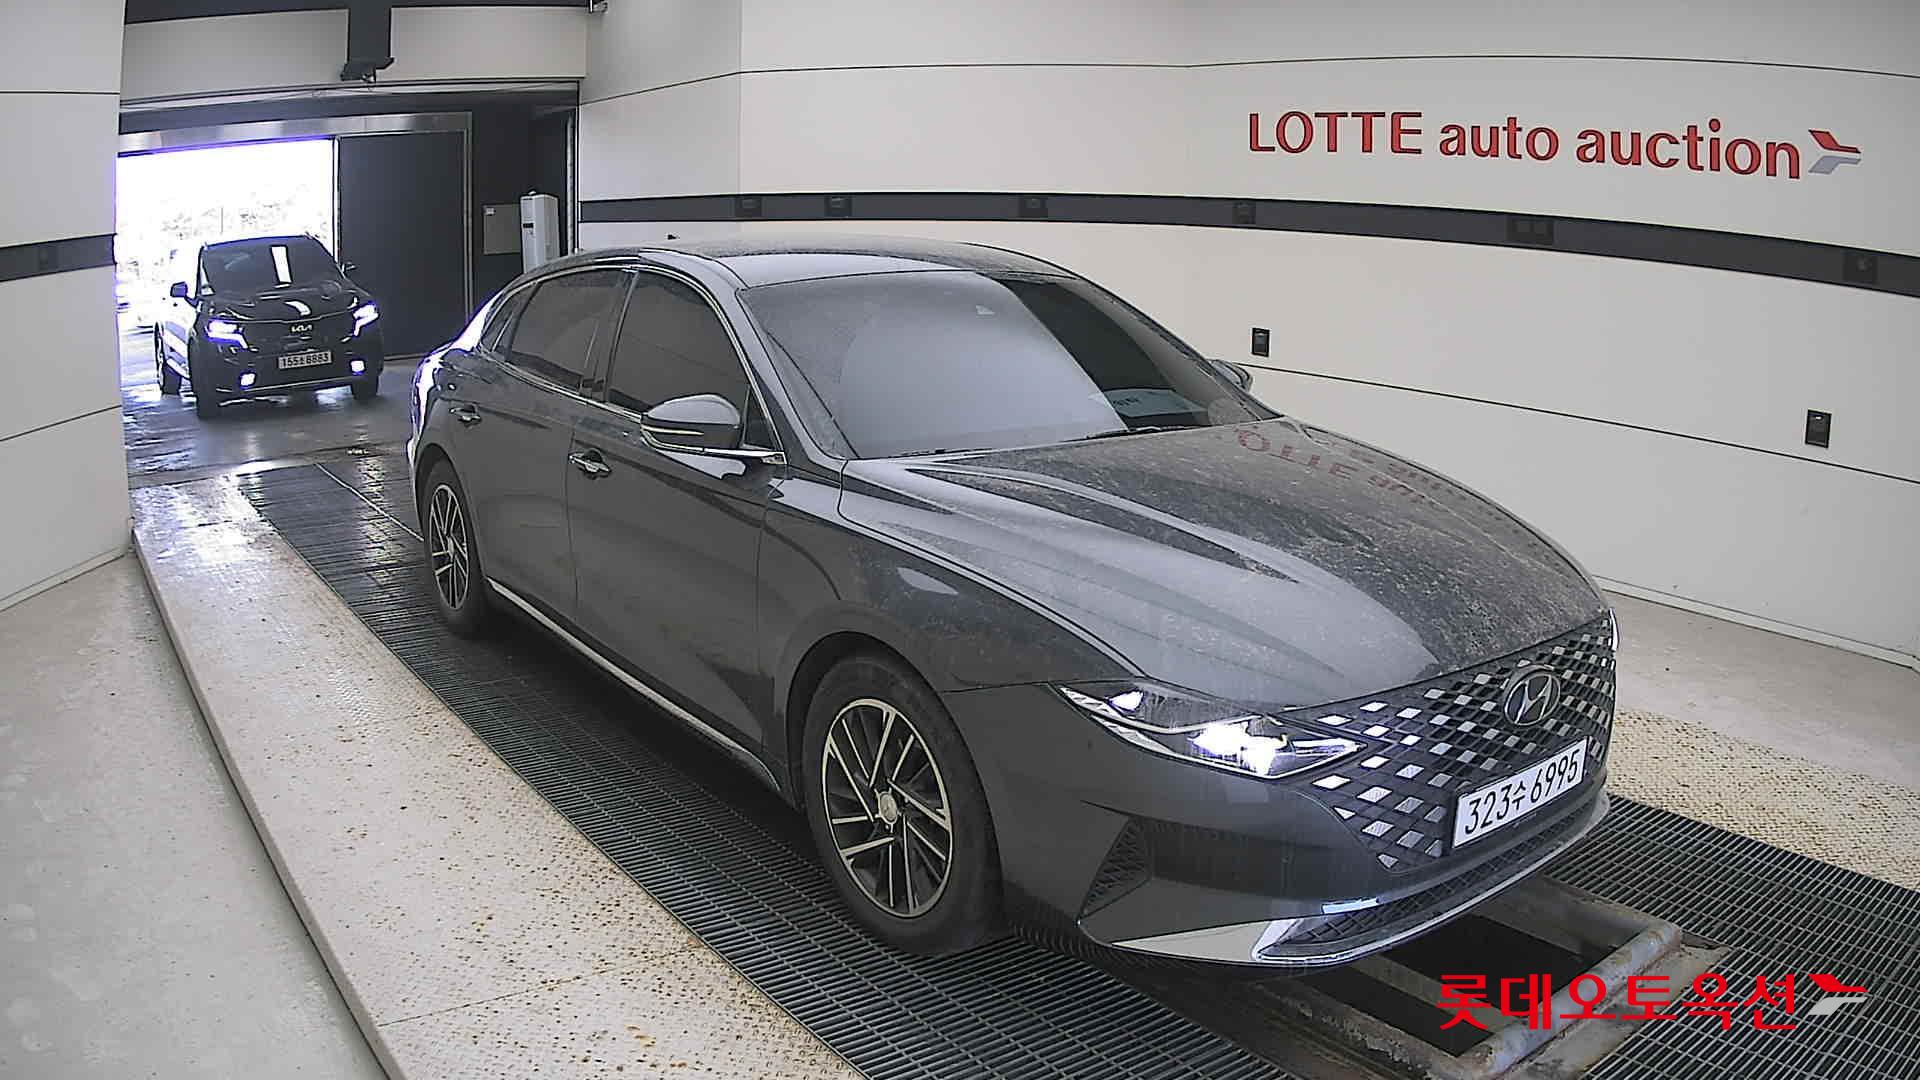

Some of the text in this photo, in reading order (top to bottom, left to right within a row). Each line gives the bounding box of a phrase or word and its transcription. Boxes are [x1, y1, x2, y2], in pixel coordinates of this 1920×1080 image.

[1248, 110, 1801, 179] LOTTE auto auction
